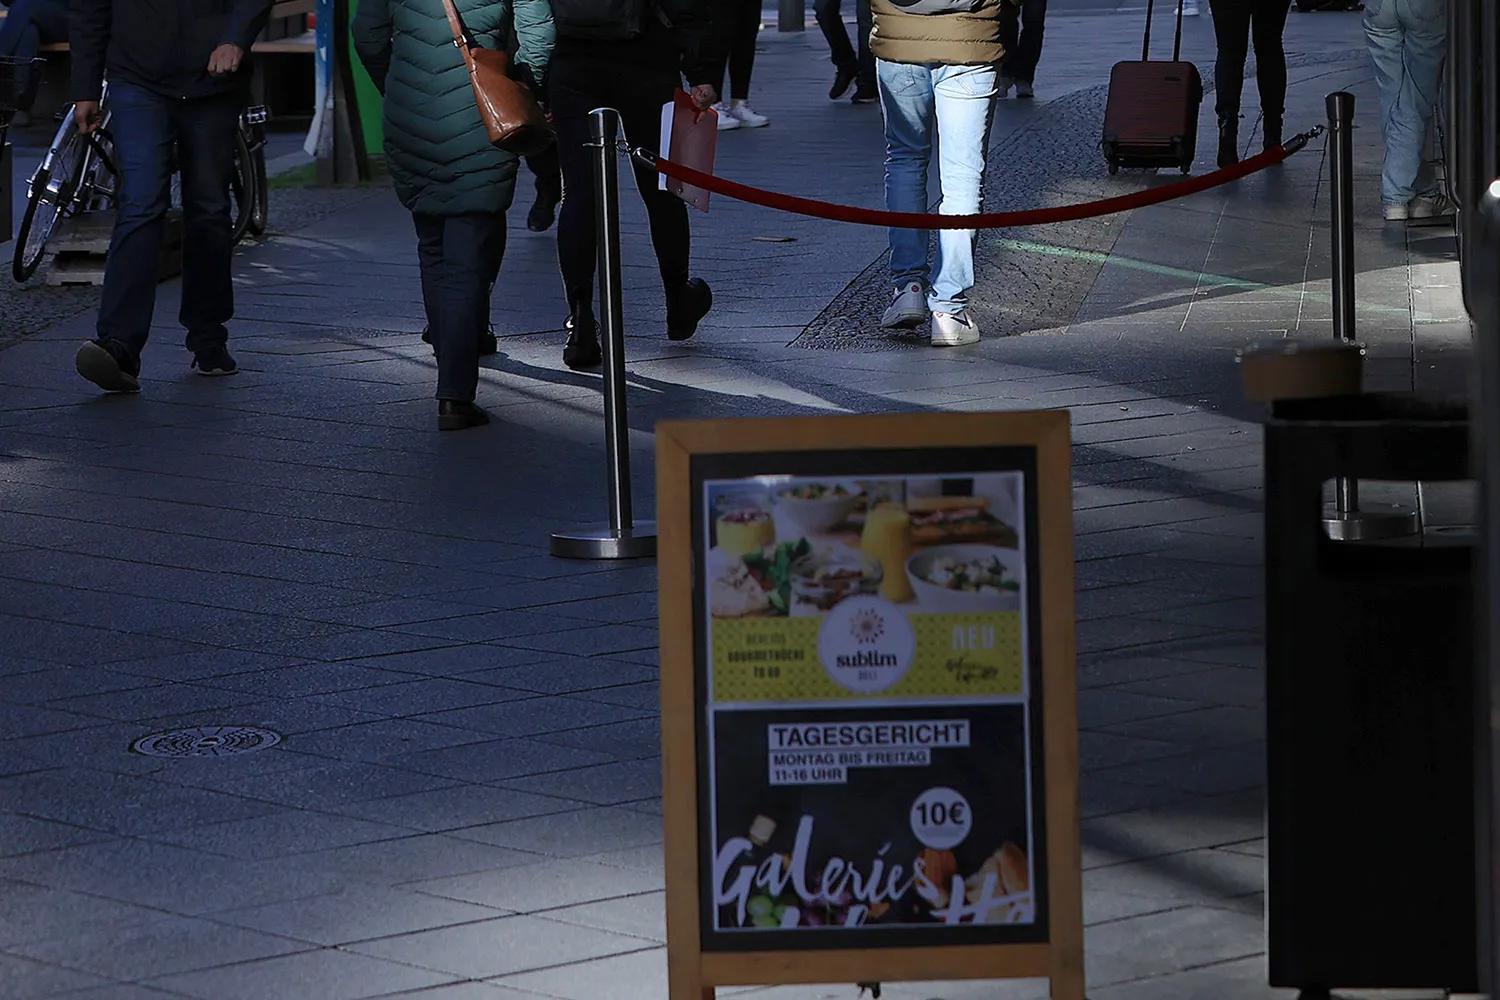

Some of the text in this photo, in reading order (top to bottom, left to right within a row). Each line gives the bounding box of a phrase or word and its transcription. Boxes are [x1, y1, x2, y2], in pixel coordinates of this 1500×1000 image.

[836, 650, 898, 668] sublim
[773, 724, 965, 746] TAGESGERICHT
[774, 750, 928, 766] MONTAG BIS FREITAG
[774, 768, 843, 782] 11-16 UHR
[915, 802, 966, 826] 10€
[716, 814, 942, 927] Galeries
